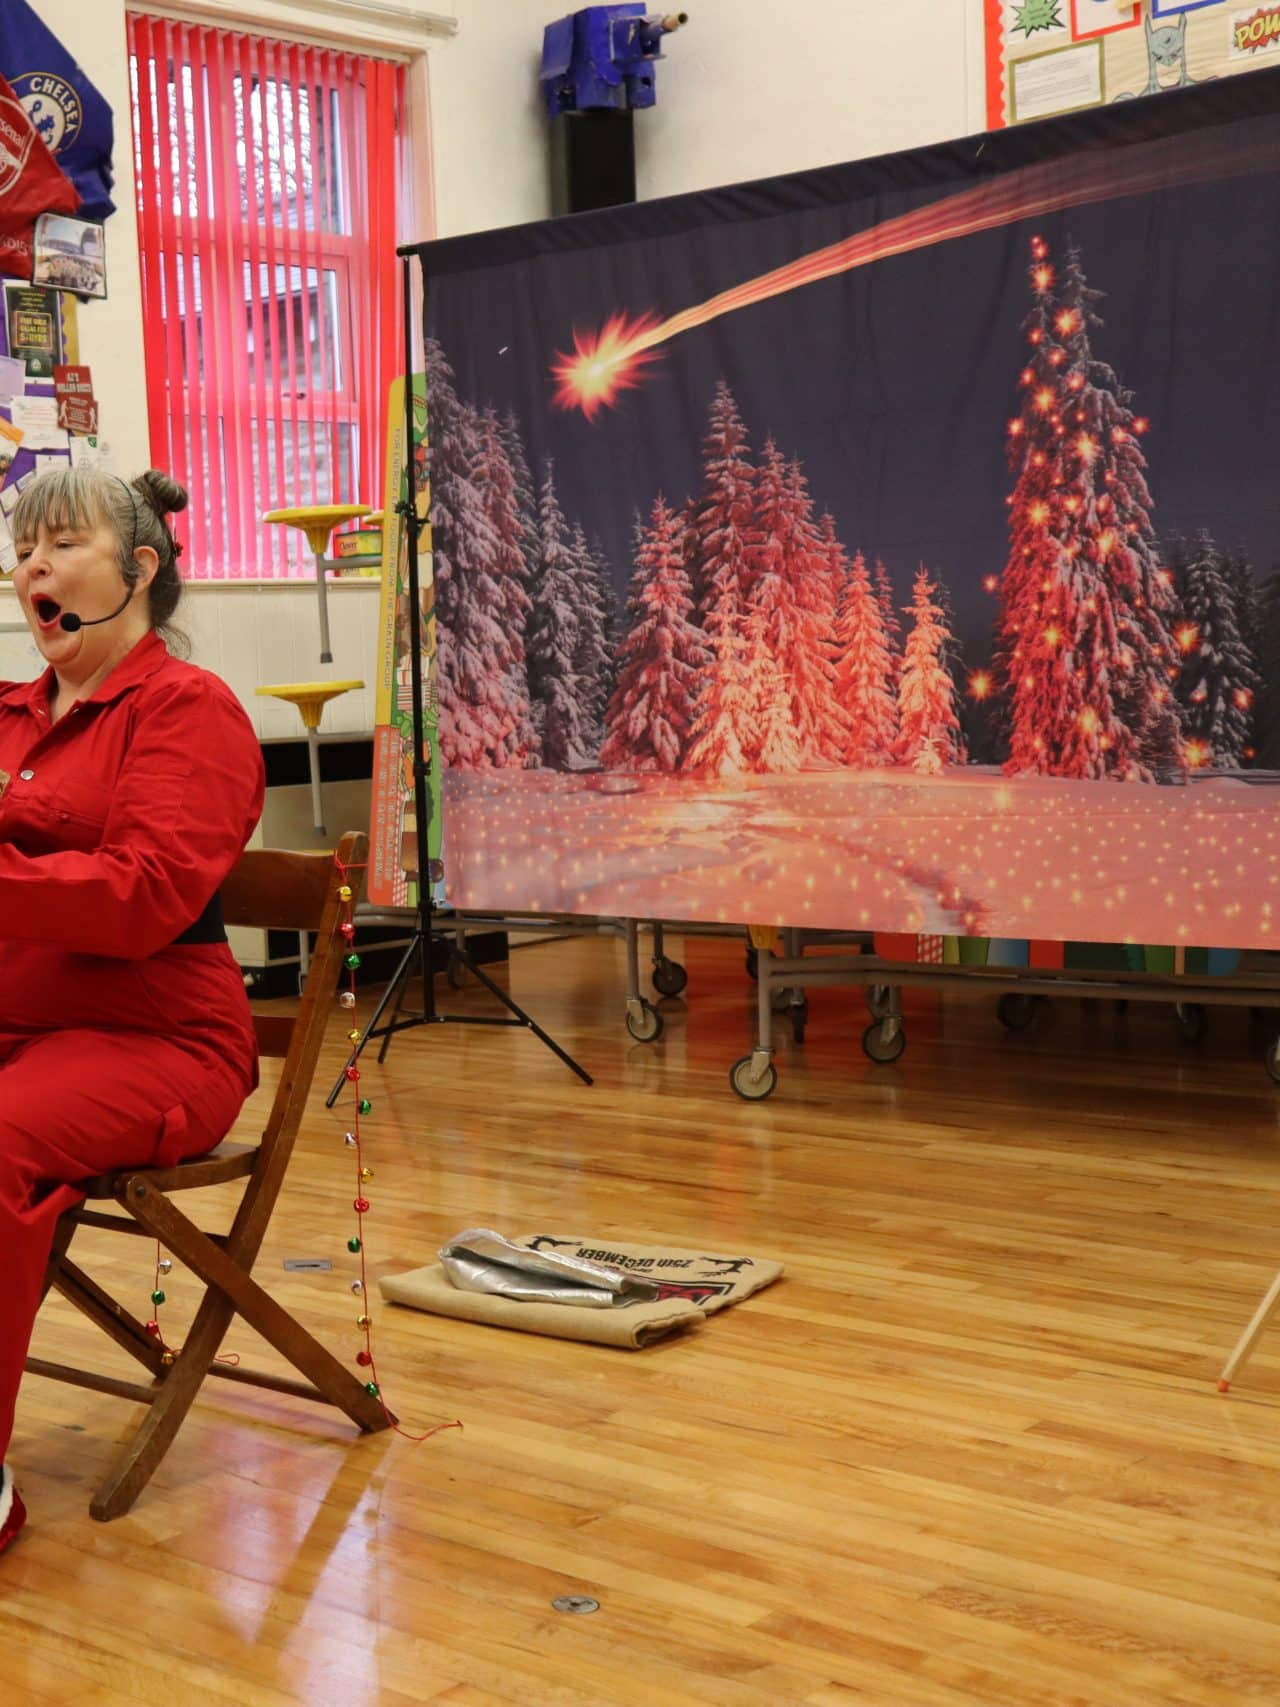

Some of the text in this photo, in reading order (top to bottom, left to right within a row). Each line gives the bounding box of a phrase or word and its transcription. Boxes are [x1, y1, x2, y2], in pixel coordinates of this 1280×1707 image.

[30, 77, 79, 133] CHELSEA
[576, 1248, 655, 1269] DECEMBER
[656, 1257, 693, 1269] 25th
